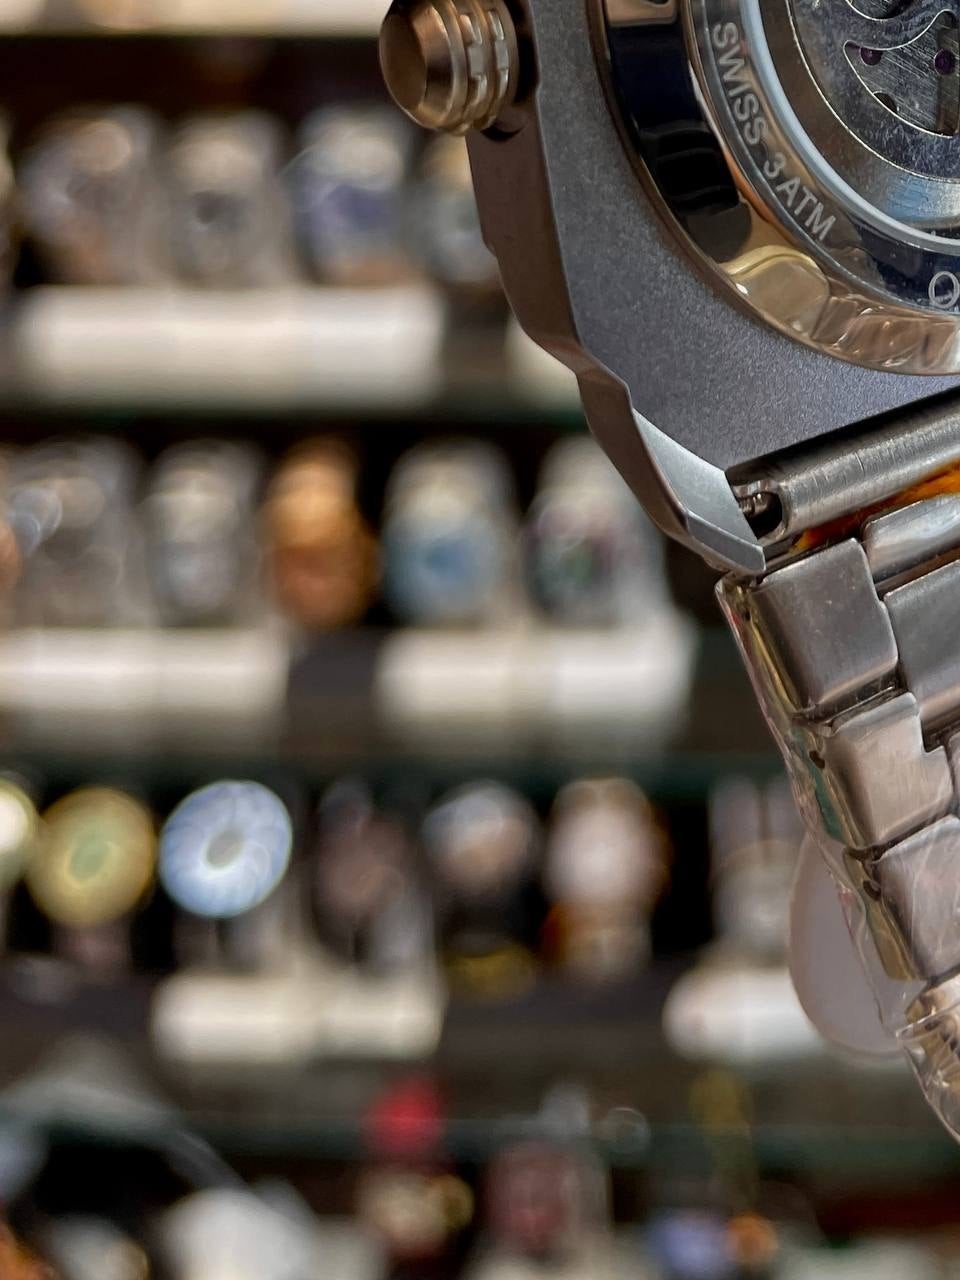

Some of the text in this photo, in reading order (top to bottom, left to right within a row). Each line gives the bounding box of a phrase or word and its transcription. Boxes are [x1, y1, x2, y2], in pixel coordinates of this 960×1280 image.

[713, 22, 837, 241] SWISS 3 ATM
